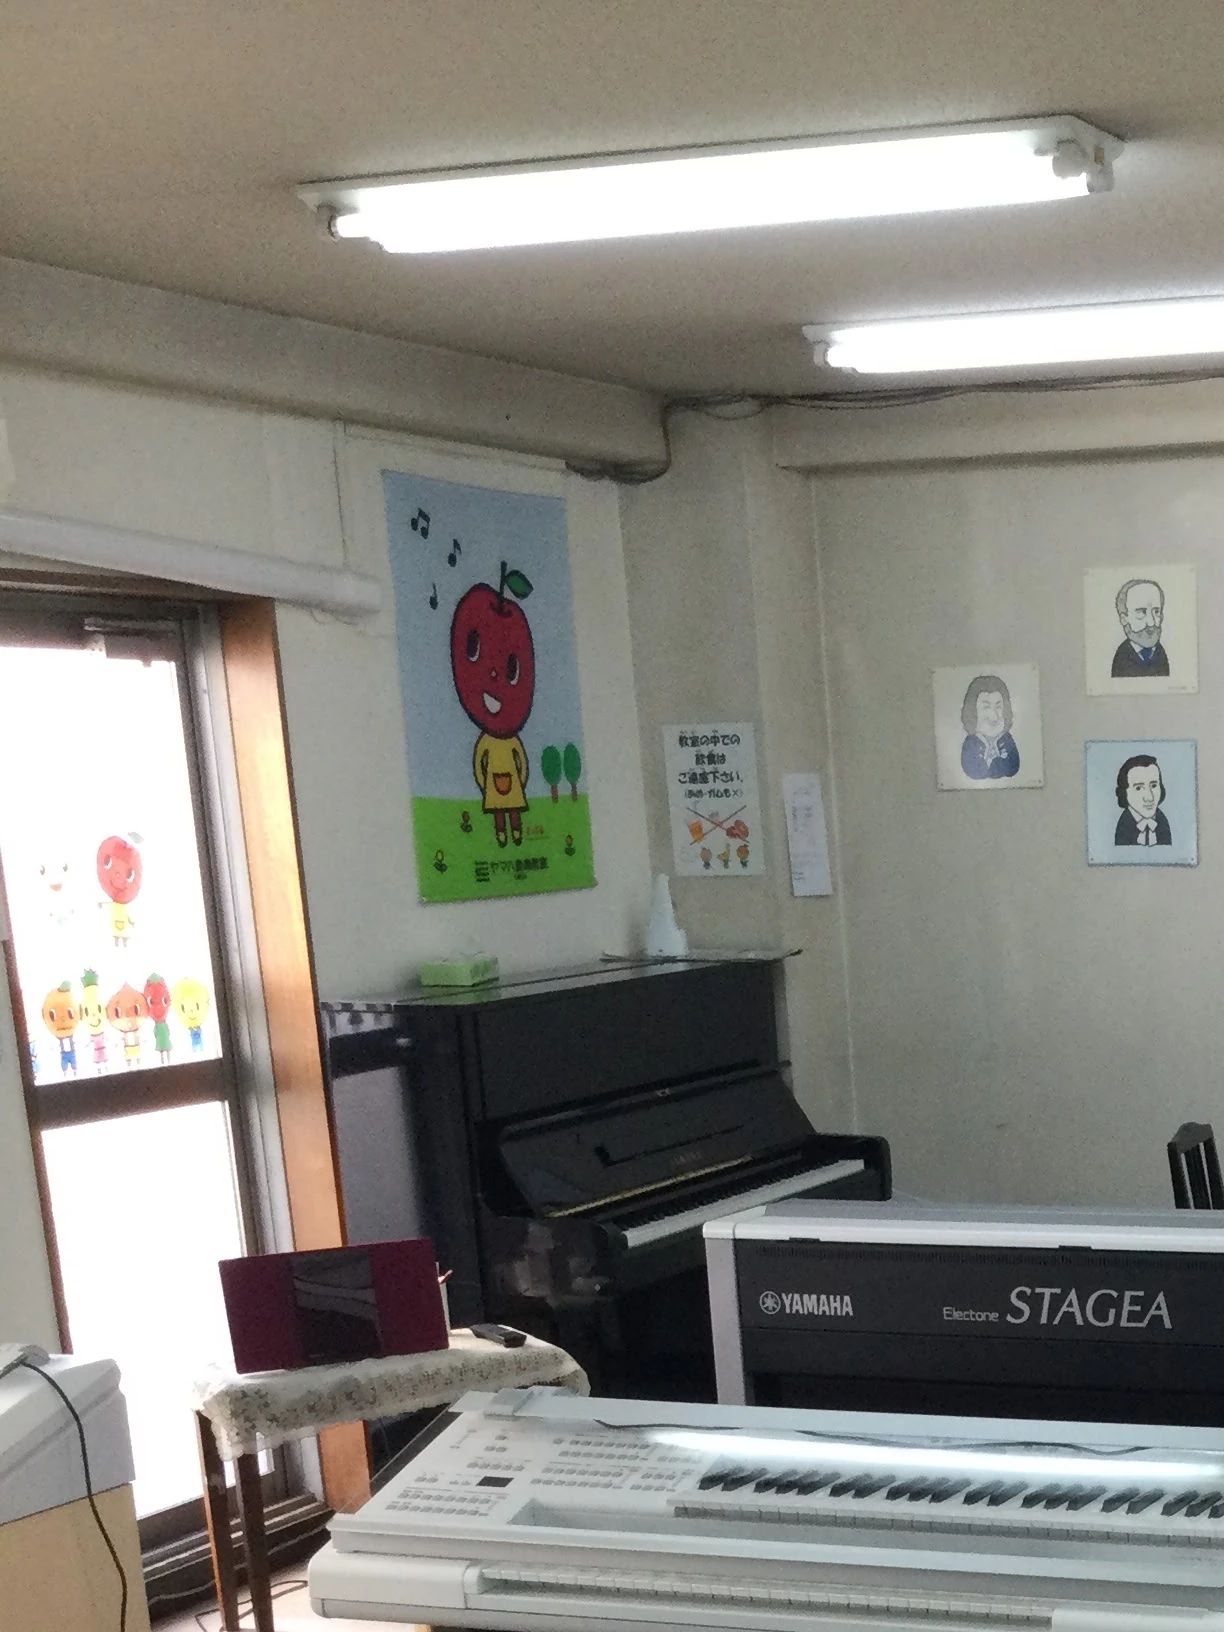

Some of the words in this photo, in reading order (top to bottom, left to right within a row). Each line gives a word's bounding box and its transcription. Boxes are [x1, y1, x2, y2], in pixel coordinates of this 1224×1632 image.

[781, 1293, 853, 1316] YAMAHA
[943, 1306, 999, 1322] Electone
[1006, 1286, 1172, 1329] STAGEA
